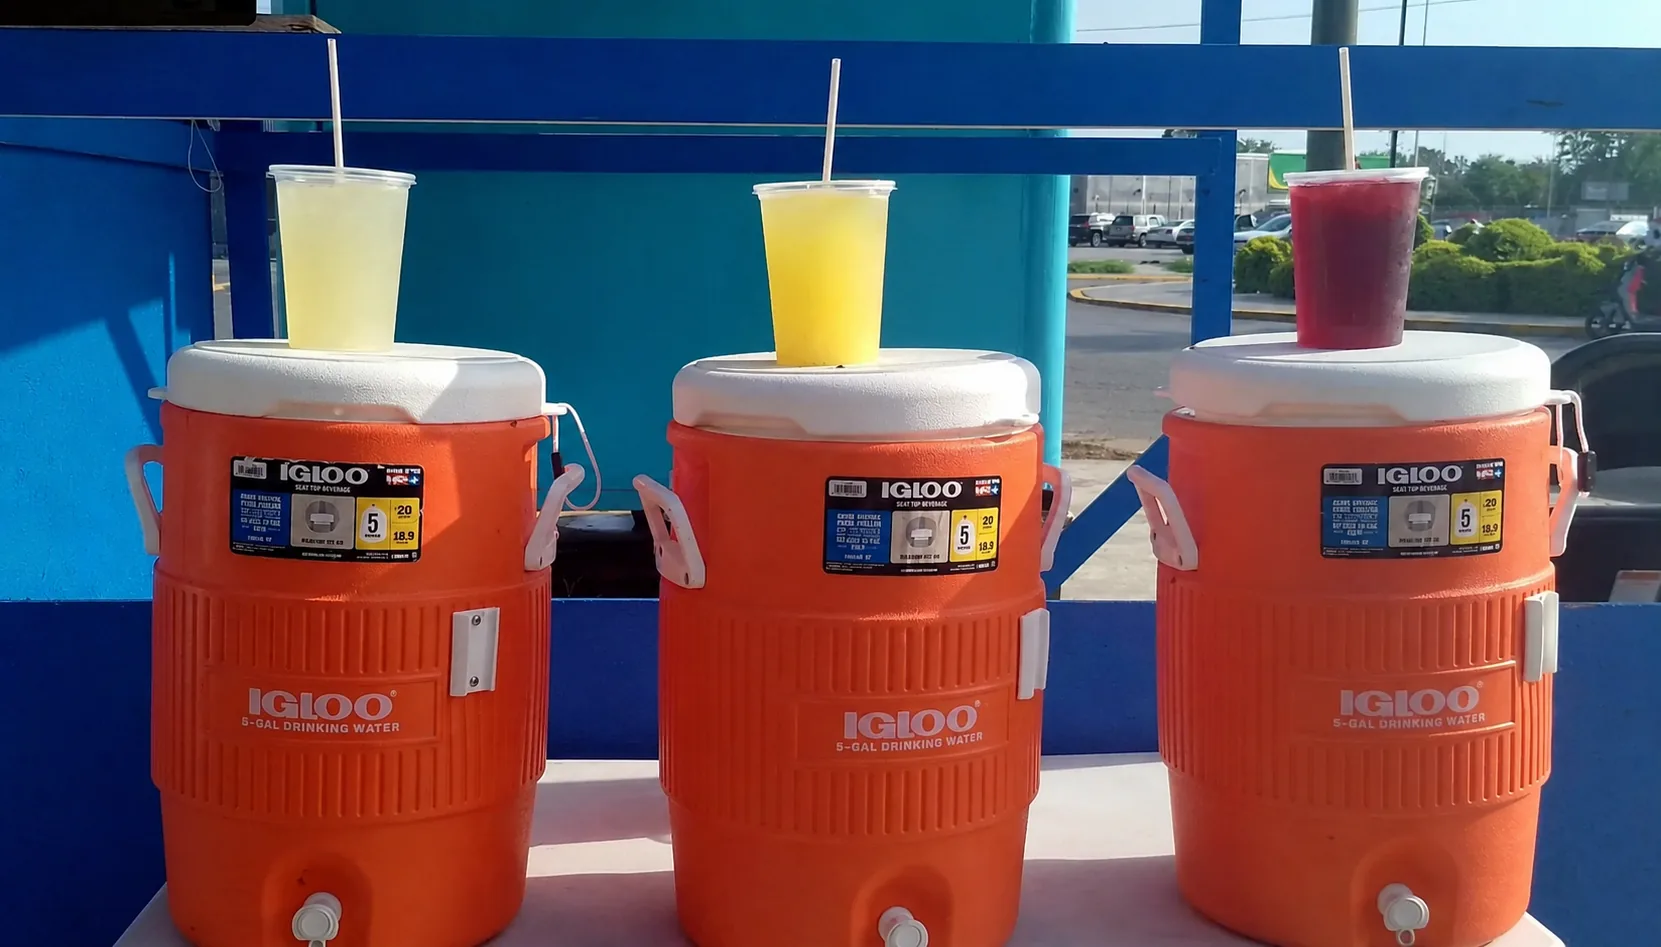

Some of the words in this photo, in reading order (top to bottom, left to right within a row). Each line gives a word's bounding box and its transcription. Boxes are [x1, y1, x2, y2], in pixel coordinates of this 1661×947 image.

[280, 462, 368, 485] IGLOO
[1378, 465, 1462, 484] IGLOO
[882, 481, 962, 498] IGLOO
[367, 513, 379, 533] 5
[1461, 509, 1470, 527] 5
[393, 531, 415, 541] 18.9
[960, 526, 969, 545] 5
[1482, 524, 1498, 533] 18.9
[979, 541, 993, 551] 18.9
[248, 688, 393, 721] IGLOO
[1340, 685, 1479, 717] IGLOO
[241, 717, 280, 730] 5-GAL
[283, 722, 349, 733] DRINKING
[353, 722, 400, 733] WATER
[844, 705, 978, 740] IGLOO
[1333, 718, 1374, 729] 5-GAL
[1379, 718, 1442, 729] DRINKING
[1447, 712, 1486, 726] WATER
[836, 742, 877, 752] 5-GAL
[881, 738, 942, 751] DRINKING
[946, 732, 983, 746] WATER
